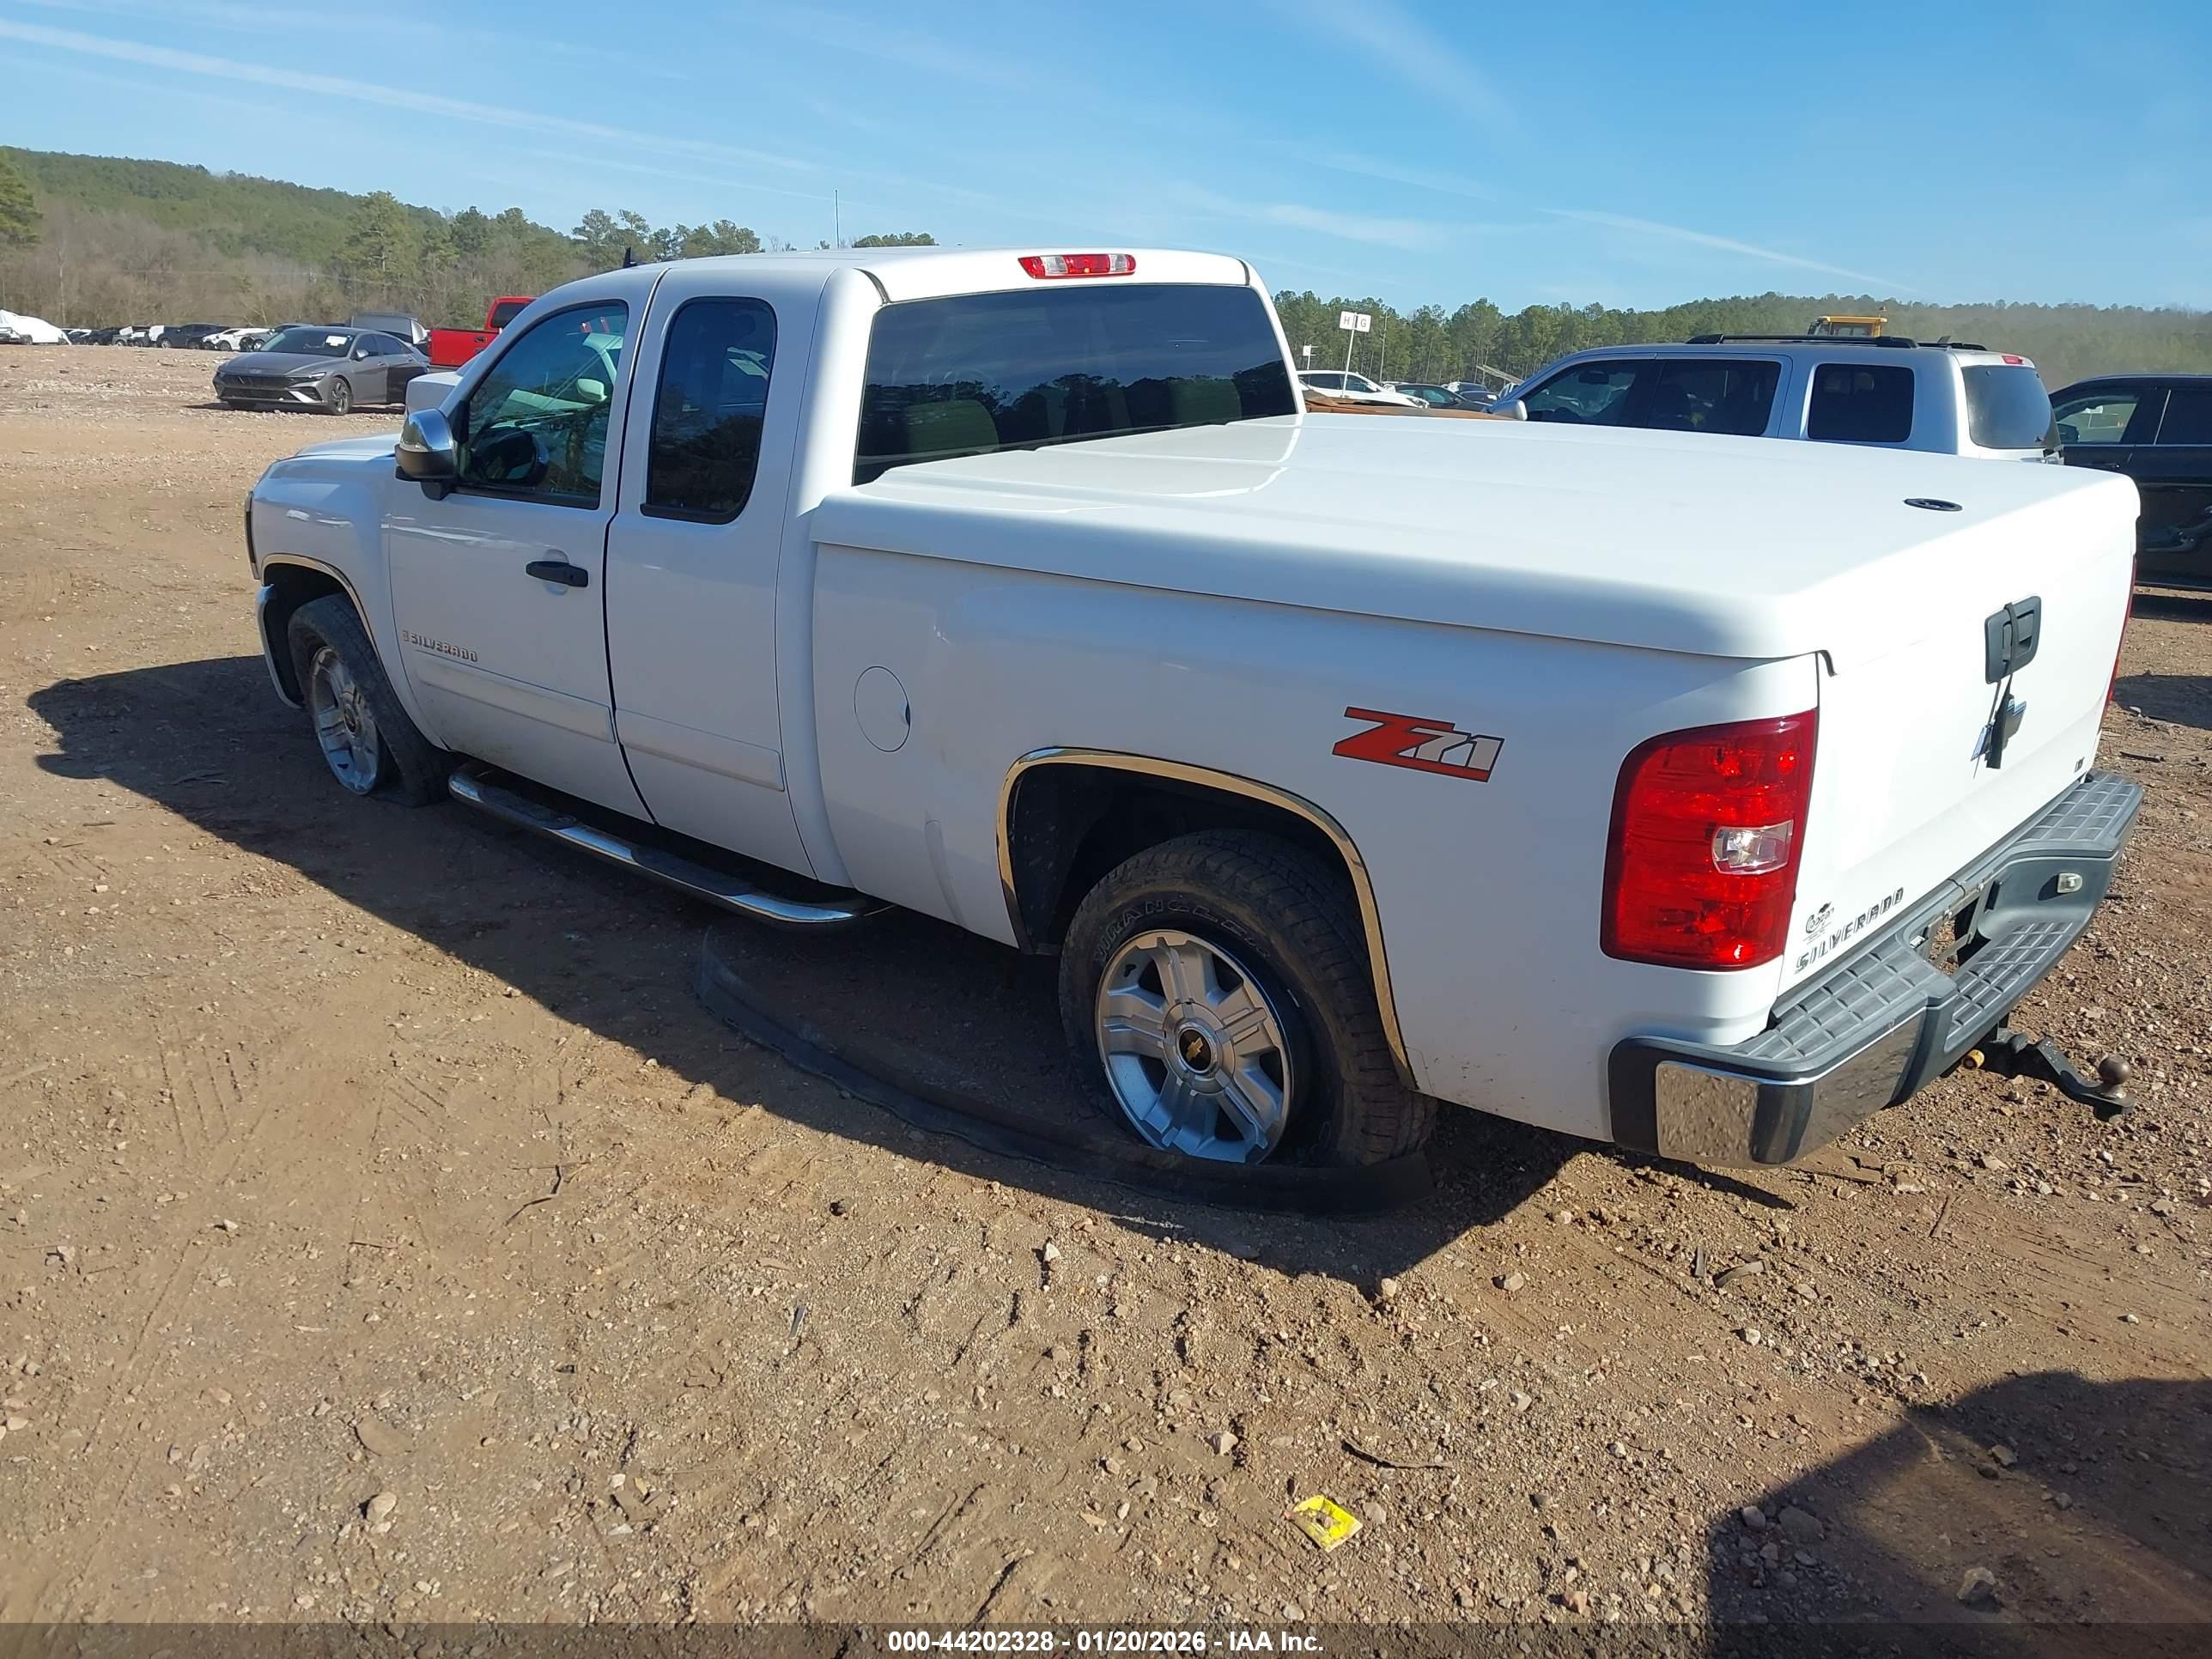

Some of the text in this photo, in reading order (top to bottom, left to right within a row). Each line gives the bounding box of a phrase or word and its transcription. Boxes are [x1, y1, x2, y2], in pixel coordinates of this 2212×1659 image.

[410, 632, 478, 663] SILVERADO
[1332, 706, 1505, 782] Z71
[1796, 887, 1904, 975] SILVERADO
